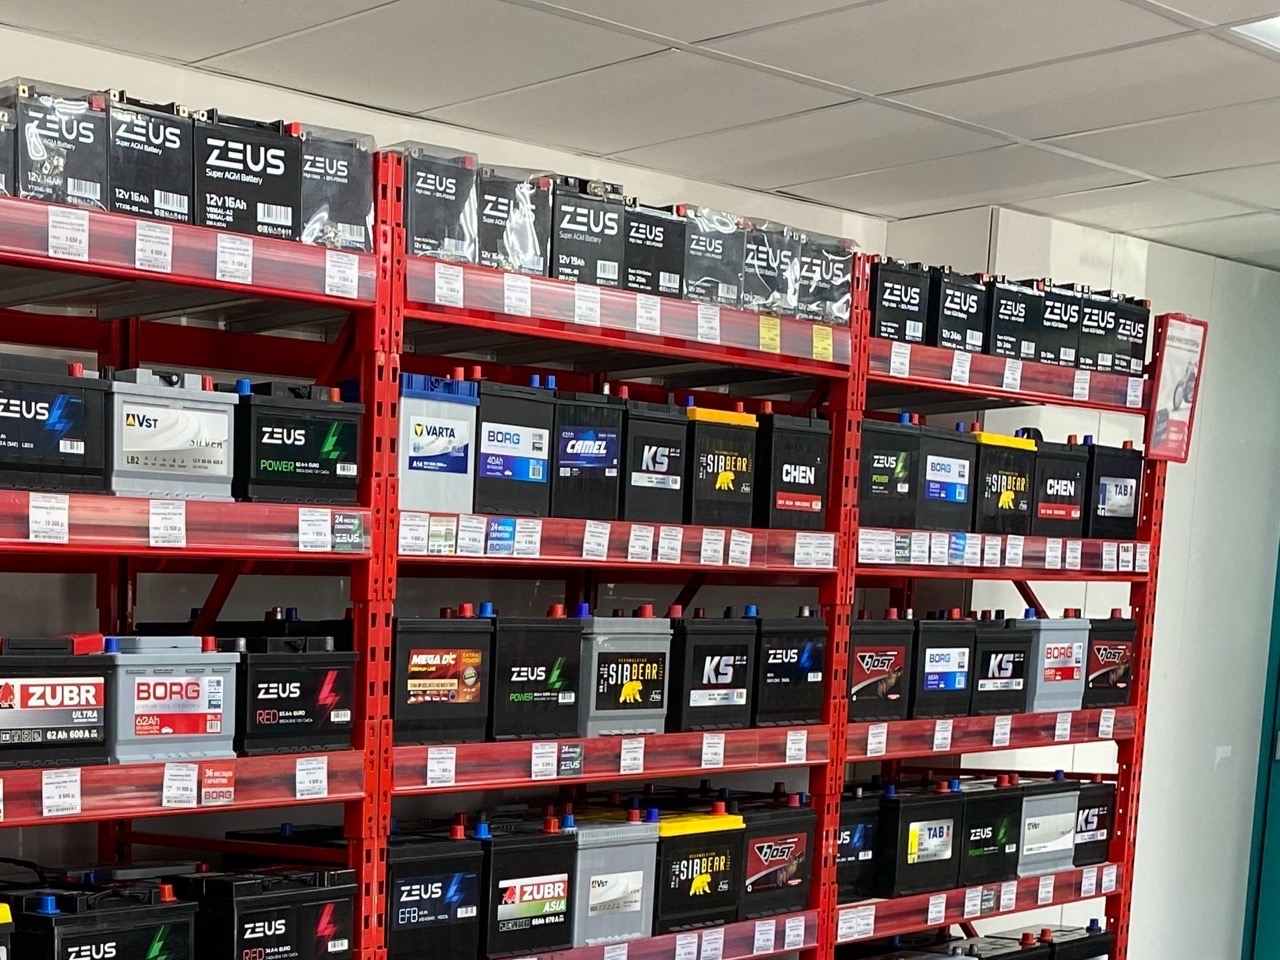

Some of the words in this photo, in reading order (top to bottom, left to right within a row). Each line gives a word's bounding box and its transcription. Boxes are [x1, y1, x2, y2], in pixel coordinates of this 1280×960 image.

[28, 111, 95, 144] ZEUS
[206, 138, 285, 175] ZEUS
[303, 155, 348, 177] ZEUS
[206, 168, 224, 179] Super
[224, 170, 239, 181] AGM
[240, 173, 263, 185] Battery
[416, 171, 456, 194] ZEUS
[115, 188, 130, 200] 12V
[131, 192, 149, 205] 16Ah
[206, 193, 223, 206] 12V
[224, 196, 247, 210] 16Ah
[560, 205, 618, 236] ZEUS
[629, 222, 664, 241] ZEUS
[690, 235, 723, 253] ZEUS
[883, 282, 920, 304] ZEUS
[944, 289, 978, 313] ZEUS
[1043, 300, 1079, 322] ZEUS
[1082, 307, 1115, 329] ZEUS
[261, 427, 305, 445] ZEUS
[425, 425, 455, 439] VARTA
[488, 431, 520, 445] BORG
[566, 440, 608, 454] CAMEL
[127, 455, 140, 465] LB2
[260, 459, 294, 472] POWER
[412, 460, 423, 468] A14
[487, 456, 503, 466] 40Ah
[641, 445, 669, 472] KS
[707, 453, 747, 473] SIBBEAR
[873, 456, 896, 468] ZEUS
[782, 464, 815, 485] CHEN
[930, 462, 951, 474] BORG
[992, 474, 1025, 492] SIBBEAR
[1046, 479, 1075, 496] CHEN
[1114, 484, 1128, 496] TAB
[768, 649, 798, 663] ZEUS
[929, 653, 950, 663] BORG
[1046, 647, 1073, 659] BORG
[511, 667, 546, 681] ZEUS
[703, 656, 734, 684] KS
[988, 653, 1014, 678] KS
[608, 664, 657, 685] SIBBEAR
[27, 685, 97, 707] ZUBR
[136, 682, 200, 700] BORG
[257, 683, 300, 699] ZEUS
[510, 693, 533, 702] POWER
[72, 710, 98, 719] ULTRA
[136, 716, 160, 726] 62Ah
[256, 710, 279, 724] RED
[47, 730, 56, 739] 62
[57, 730, 68, 739] Ah
[204, 791, 232, 800] BORG
[1076, 808, 1098, 832] KS
[928, 826, 944, 839] TAB
[970, 827, 992, 841] ZEUS
[680, 856, 725, 881] SIBBEAR
[400, 883, 442, 902] ZEUS
[523, 882, 564, 900] ZUBR
[543, 900, 565, 912] ASIA
[399, 907, 418, 924] EFB
[243, 919, 286, 939] ZEUS
